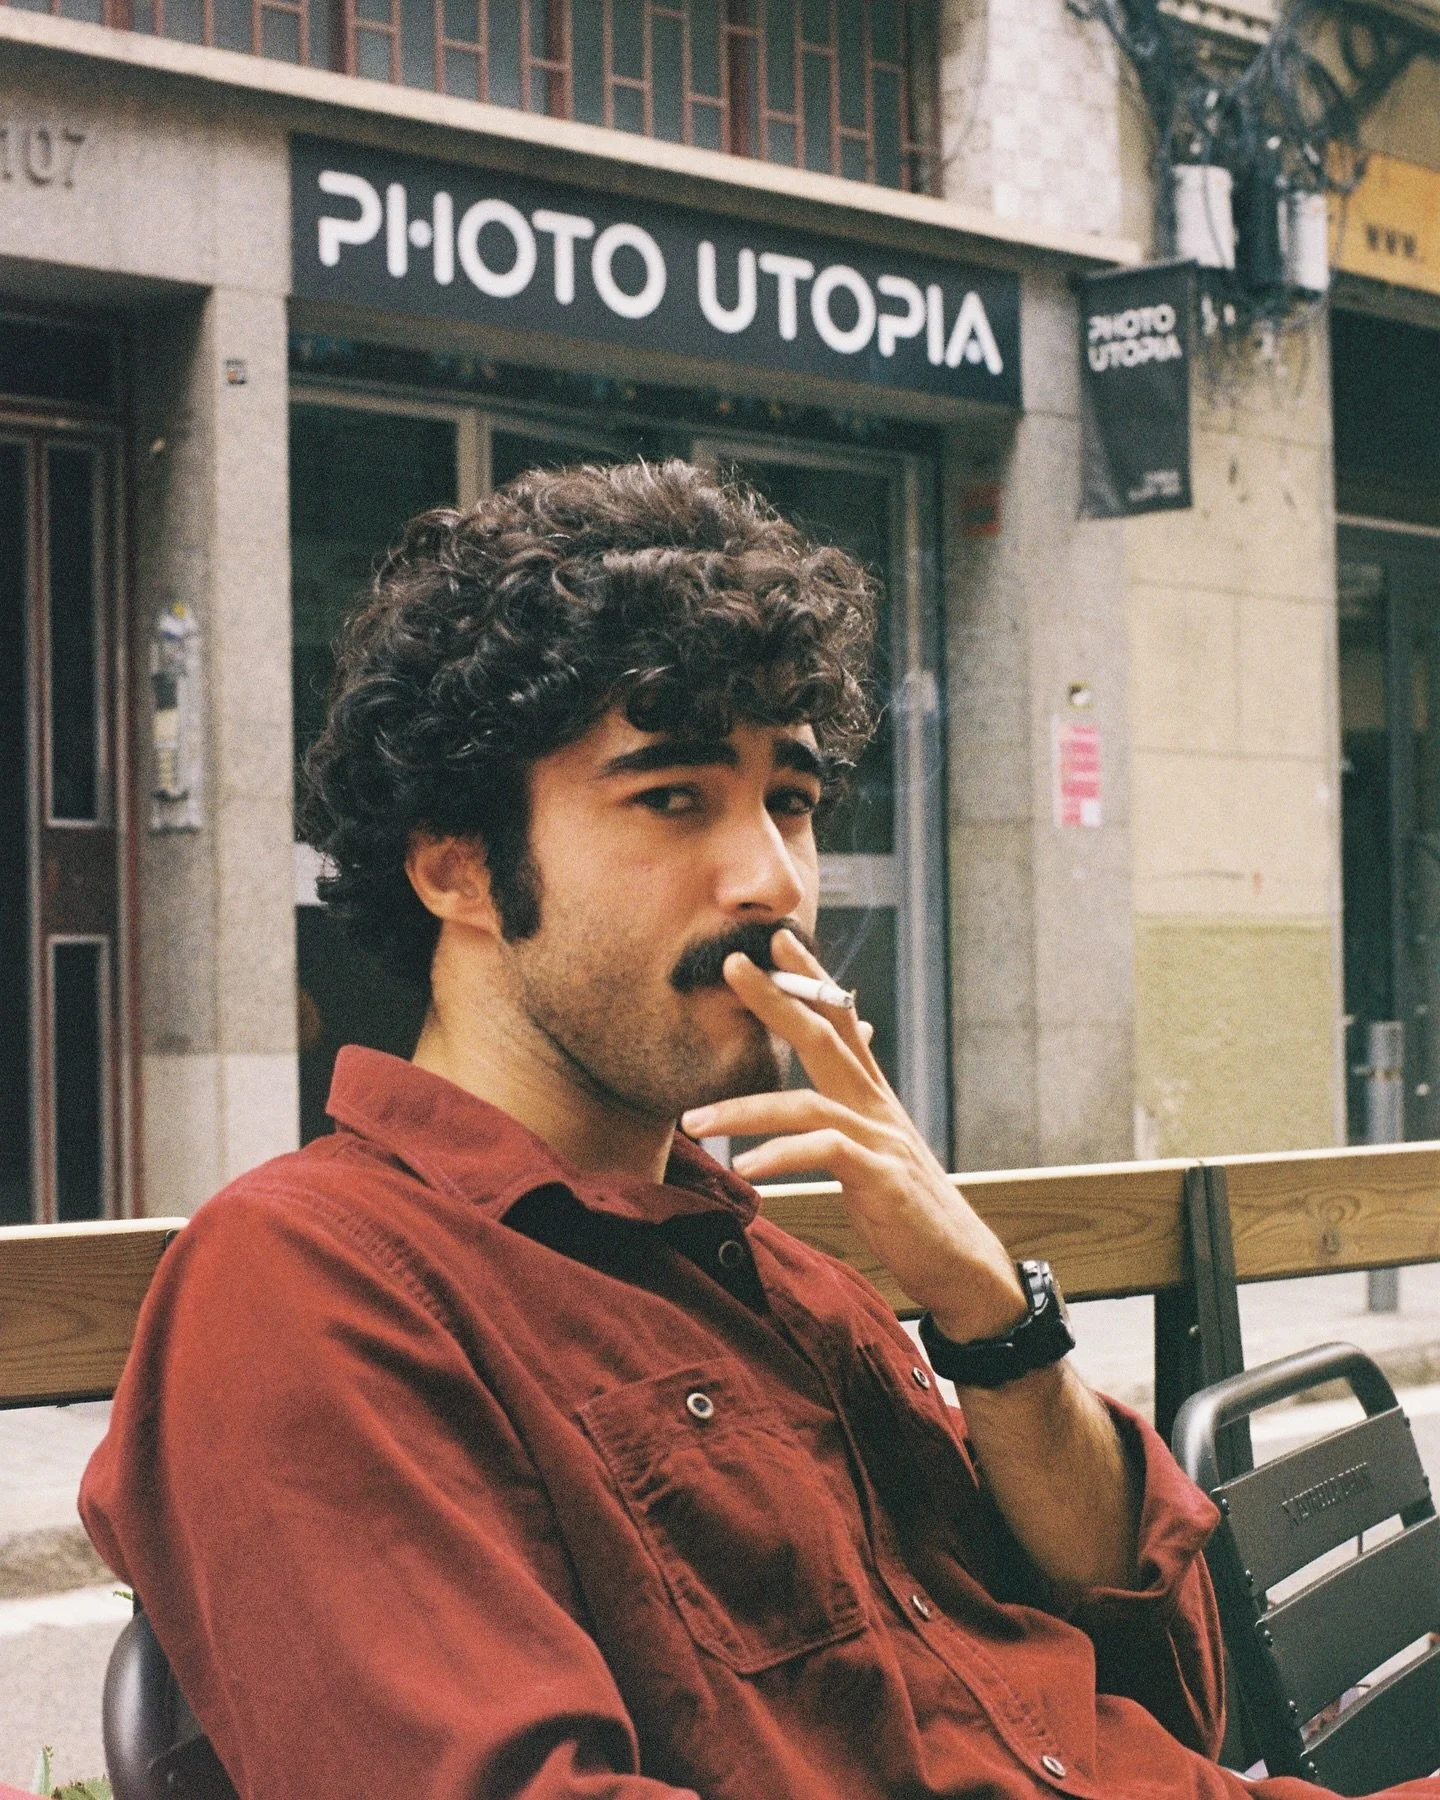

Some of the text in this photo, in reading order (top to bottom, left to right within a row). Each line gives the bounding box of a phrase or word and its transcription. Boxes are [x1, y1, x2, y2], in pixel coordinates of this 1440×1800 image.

[317, 170, 1005, 375] PHOTO UTOPIA
[1087, 304, 1176, 343] PHOTO
[1087, 336, 1183, 372] UTOPIA
